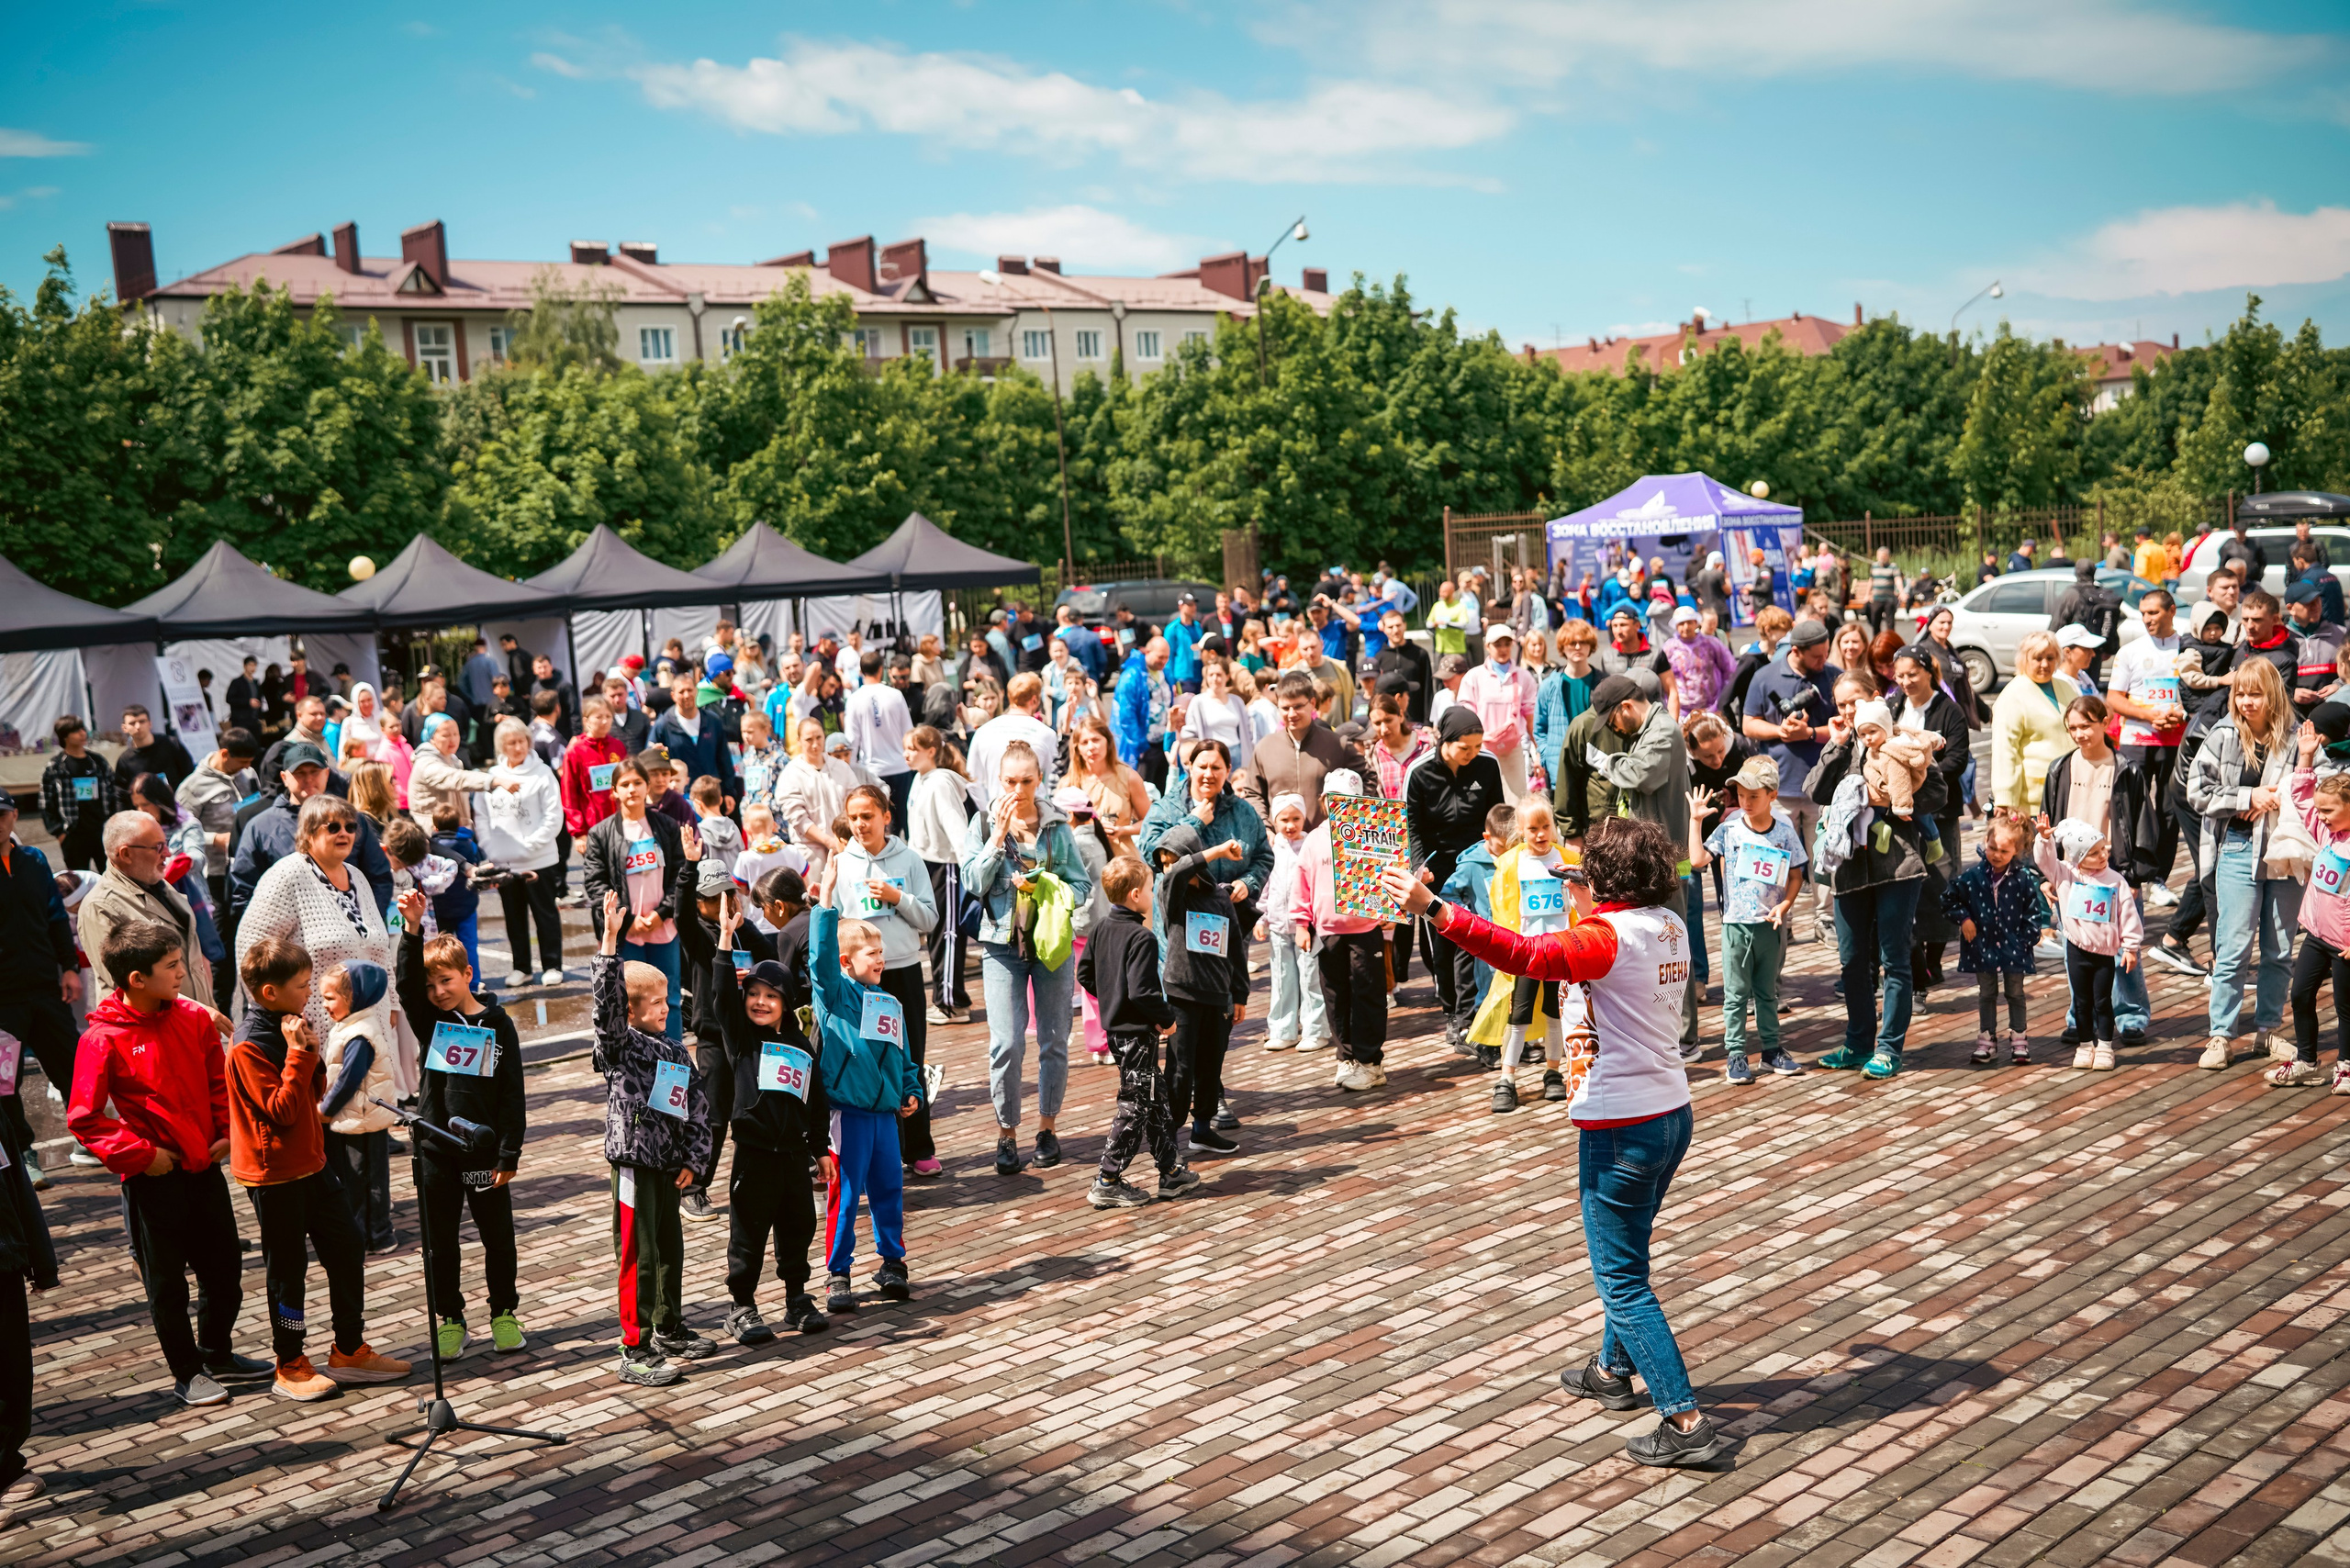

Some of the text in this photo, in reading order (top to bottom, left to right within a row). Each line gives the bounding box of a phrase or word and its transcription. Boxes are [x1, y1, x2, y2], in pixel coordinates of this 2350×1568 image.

[1551, 514, 1717, 538] ЗОНА ВОССТАНОВЛЕНИЯ
[2148, 689, 2174, 699] 231
[625, 851, 656, 869] 259
[1753, 860, 1774, 878] 15
[2315, 863, 2339, 886] 30
[1528, 892, 1564, 911] 676
[2084, 900, 2107, 916] 14
[1199, 929, 1220, 947] 62
[1659, 960, 1688, 985] ЕЛЕНА
[877, 1014, 898, 1037] 59
[445, 1045, 478, 1067] 67
[777, 1065, 803, 1090] 55
[462, 1170, 494, 1184] NIK
